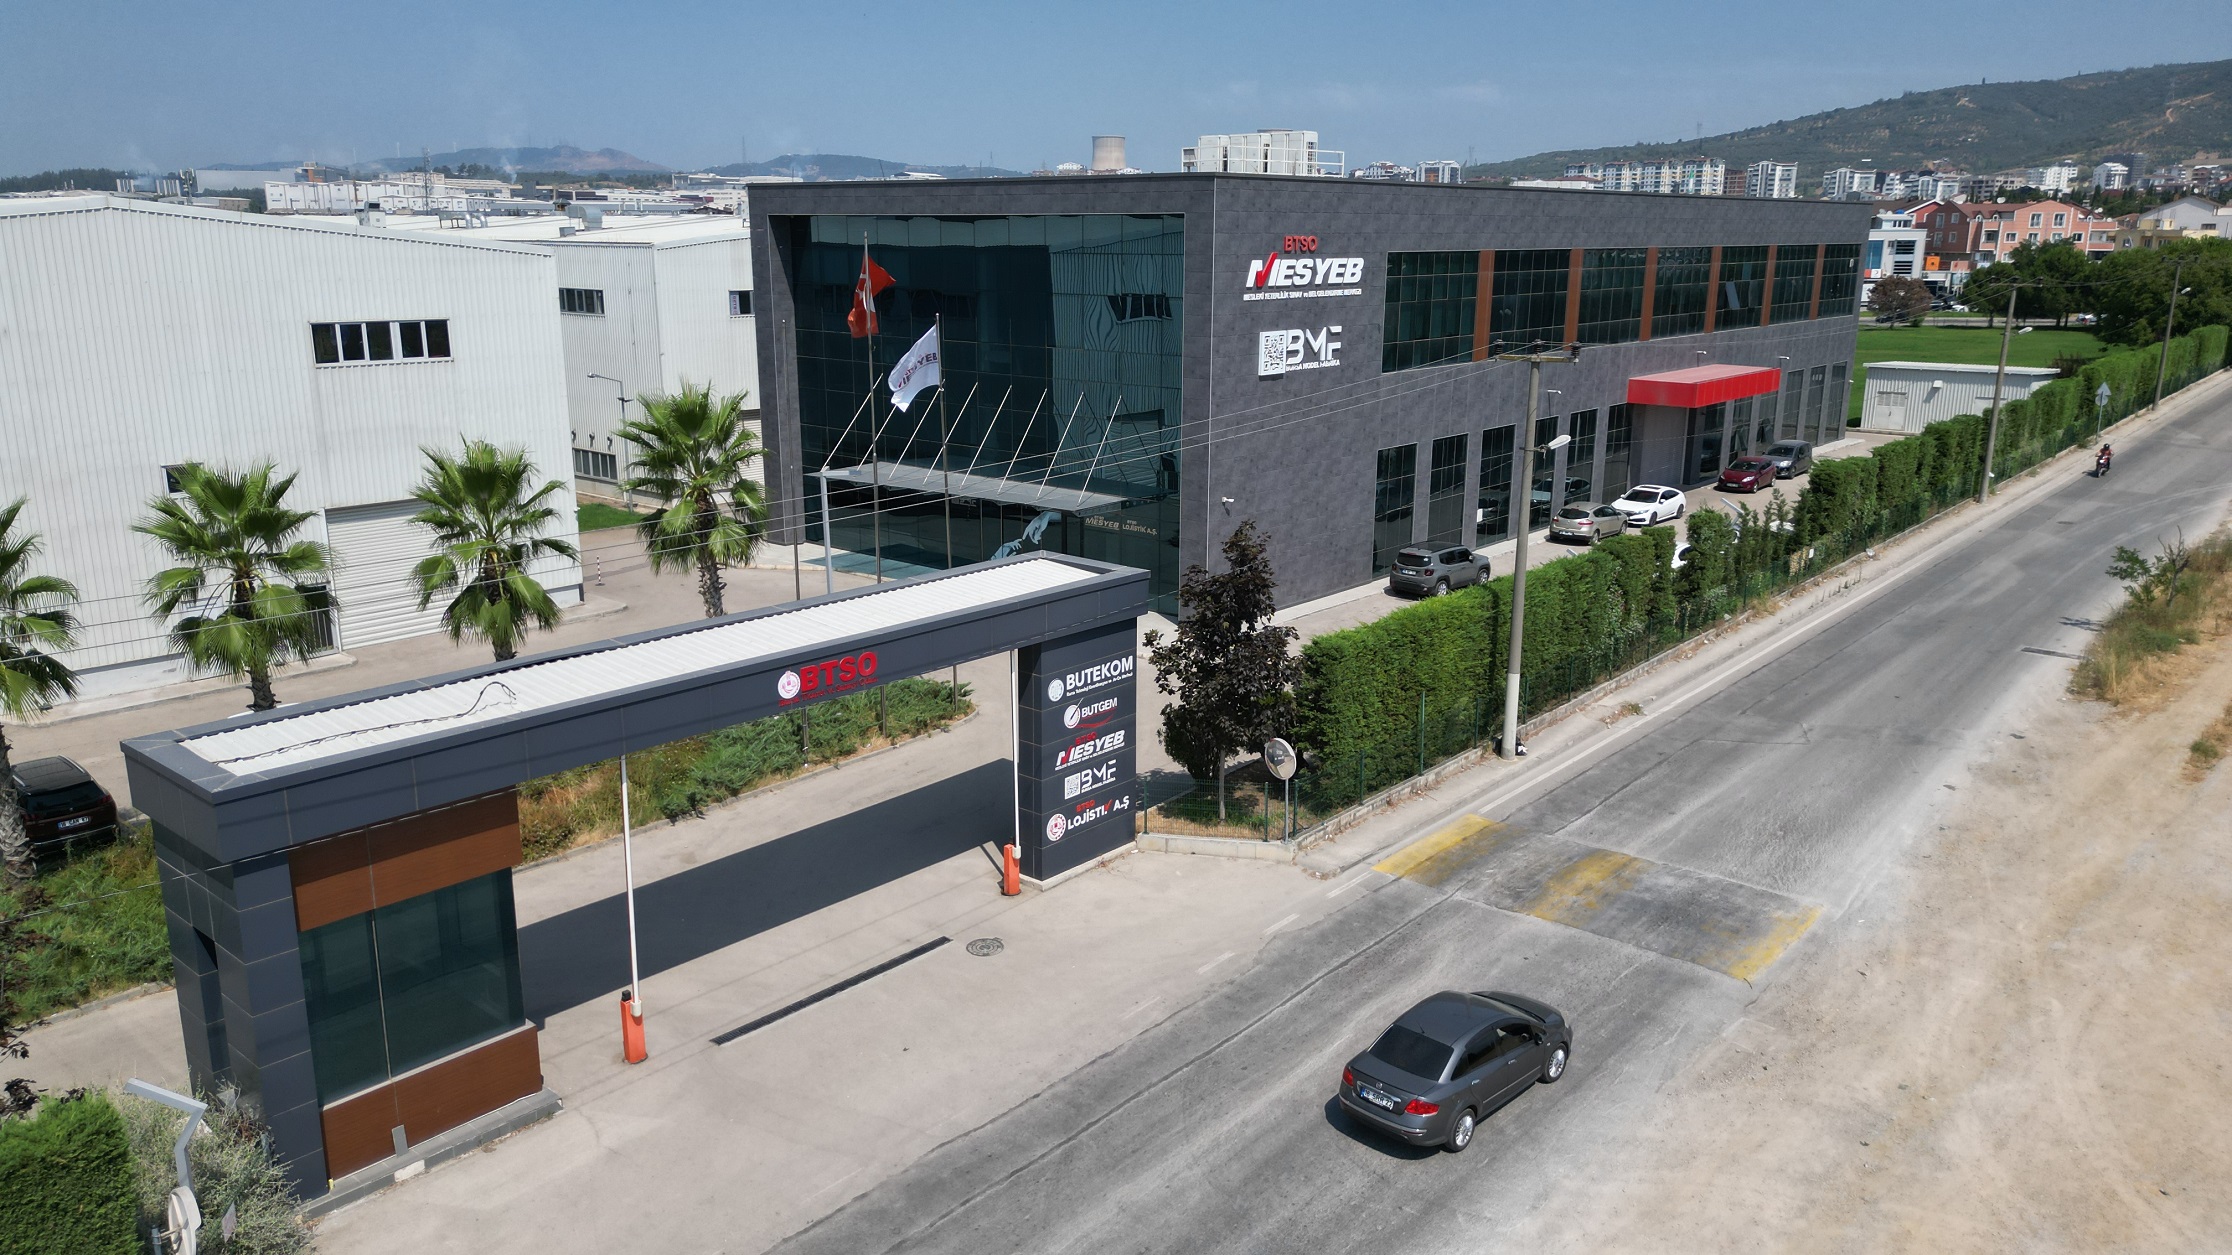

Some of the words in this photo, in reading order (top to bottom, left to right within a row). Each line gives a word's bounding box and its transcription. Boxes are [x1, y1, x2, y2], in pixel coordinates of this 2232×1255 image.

[1284, 235, 1318, 251] BTSO
[1245, 252, 1365, 289] MESYEB
[1286, 326, 1342, 364] BMF
[800, 651, 878, 692] BTSO
[1066, 655, 1133, 690] BUTEKOM
[1081, 697, 1118, 717] BUTGEM
[1081, 759, 1116, 788] BMF
